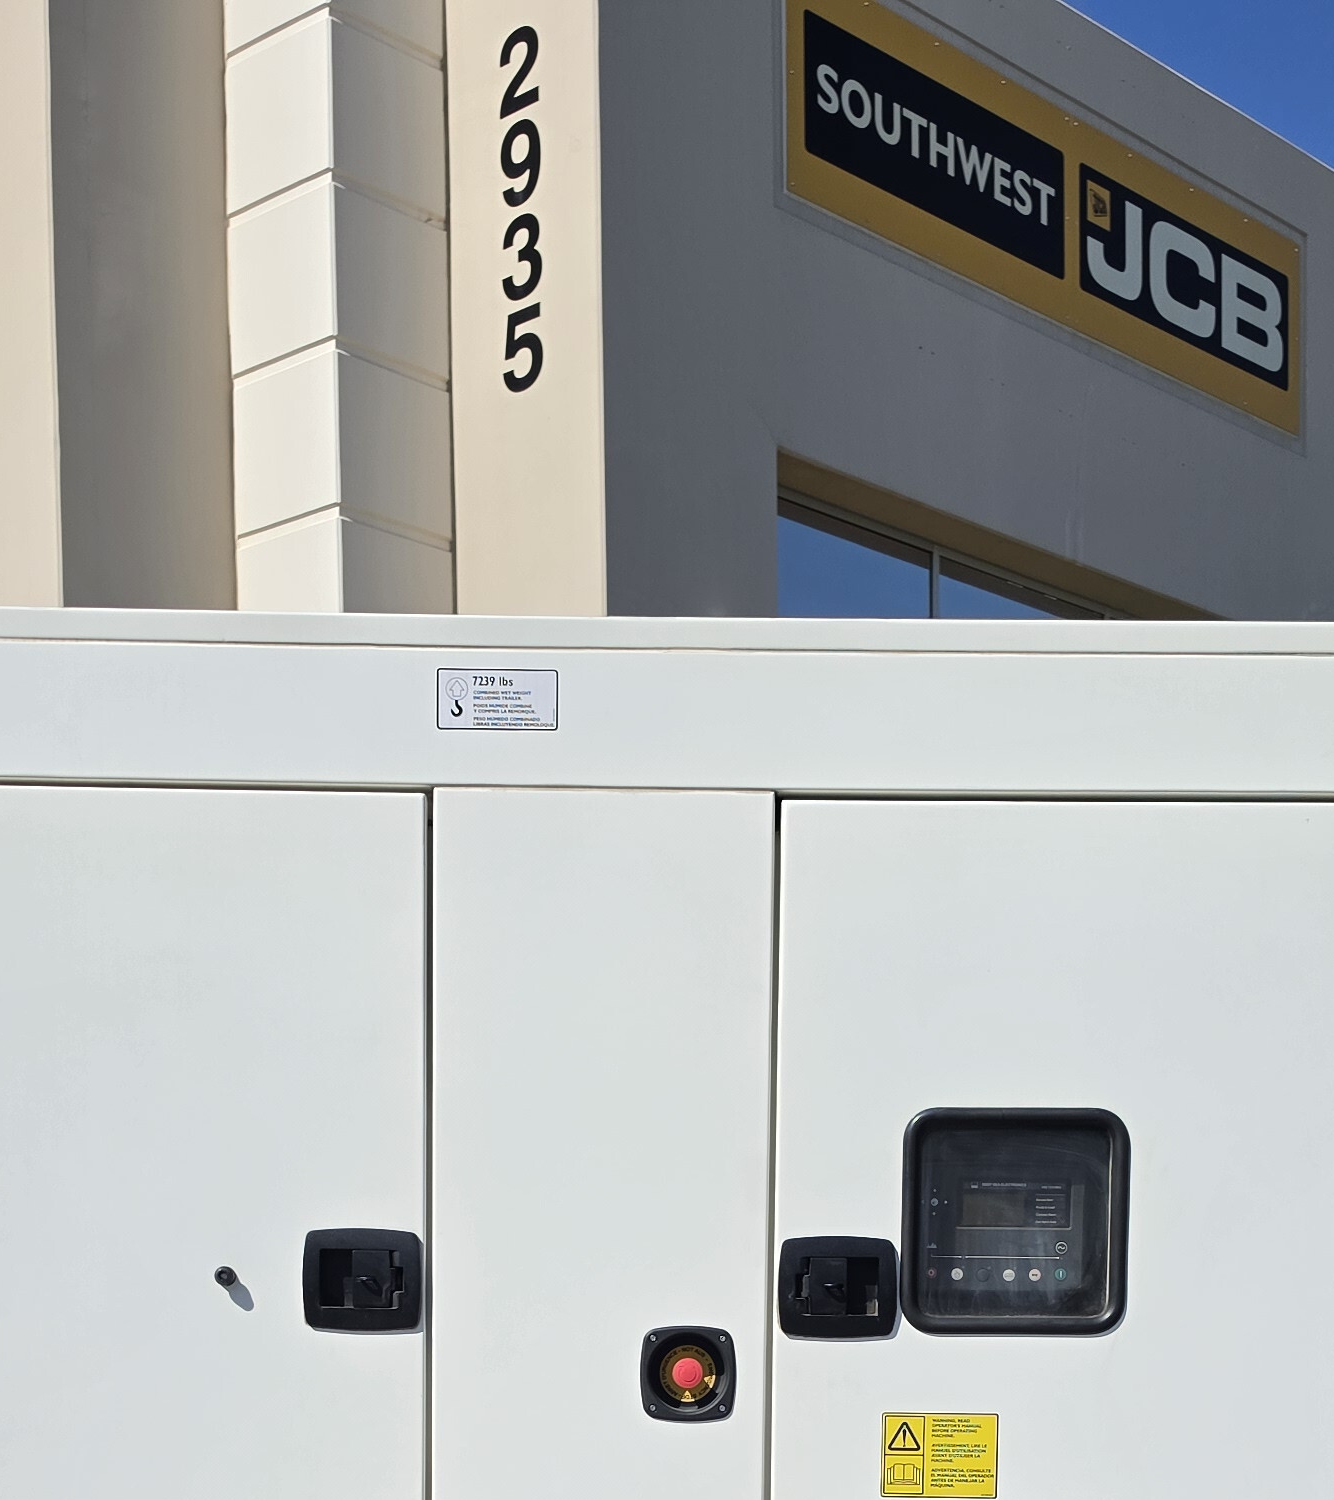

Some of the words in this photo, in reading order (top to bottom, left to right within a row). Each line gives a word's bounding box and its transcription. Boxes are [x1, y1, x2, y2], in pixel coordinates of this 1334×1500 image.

[499, 25, 544, 393] 2935
[816, 64, 1056, 226] SOUTHWEST
[1086, 200, 1284, 373] JCB
[472, 676, 495, 687] 7239
[499, 676, 514, 687] lbs
